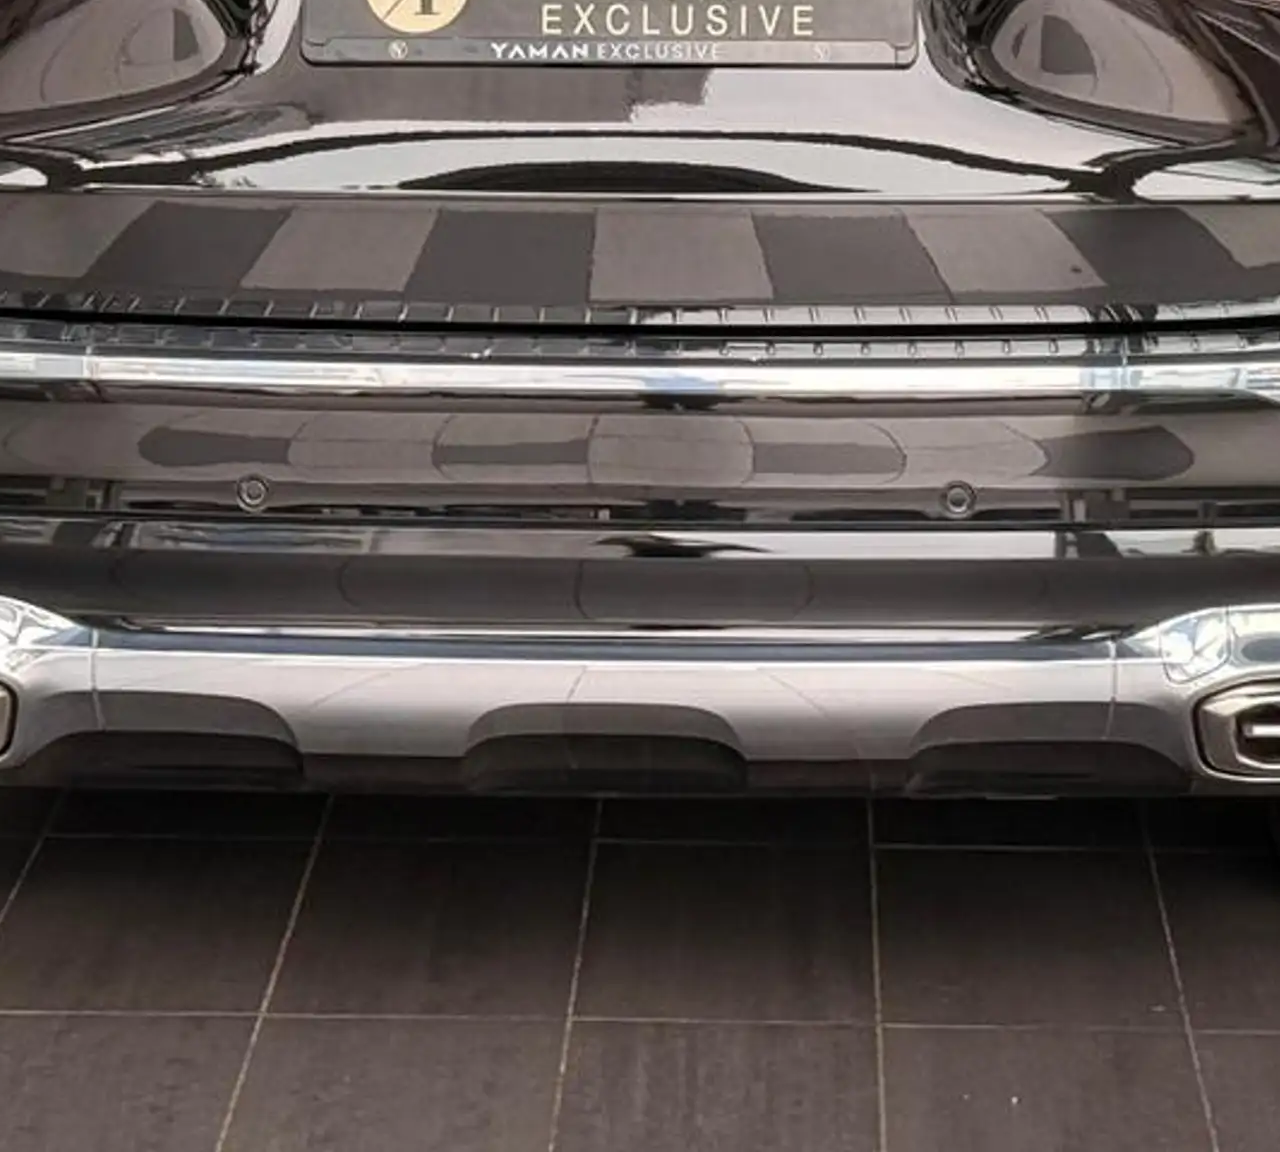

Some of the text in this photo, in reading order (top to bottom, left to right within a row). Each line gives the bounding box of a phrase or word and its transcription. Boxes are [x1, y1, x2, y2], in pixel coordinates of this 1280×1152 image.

[541, 3, 815, 37] EXCLUSIVE
[490, 42, 721, 60] YAMAN EXCLUSIVE
